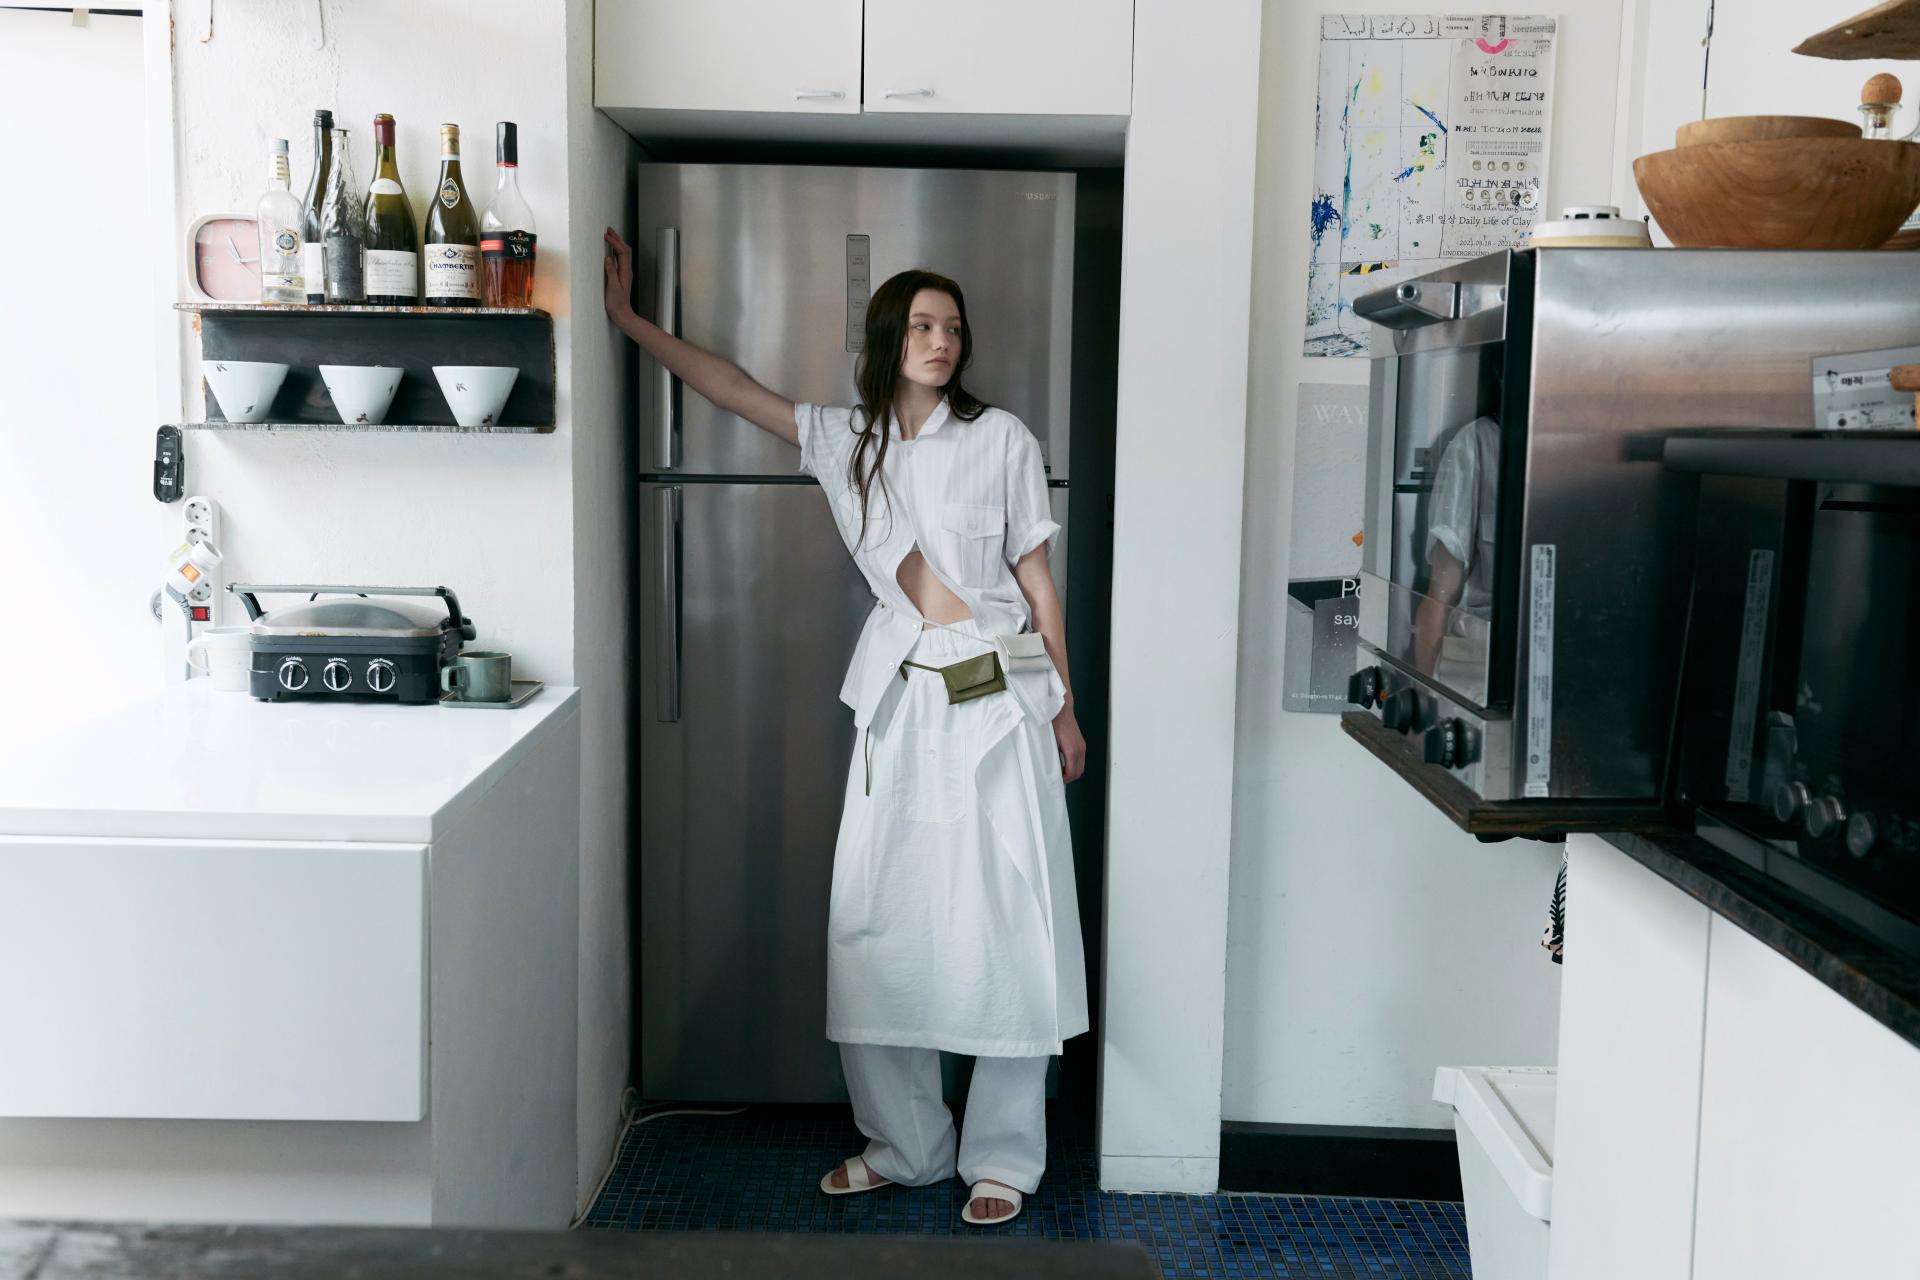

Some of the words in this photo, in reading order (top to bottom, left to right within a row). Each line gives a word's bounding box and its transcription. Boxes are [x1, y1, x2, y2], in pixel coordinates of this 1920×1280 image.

[1459, 216, 1481, 228] Daily
[1483, 216, 1499, 226] Life
[1501, 215, 1511, 225] of
[1512, 217, 1532, 228] Clay
[1334, 614, 1360, 629] say
